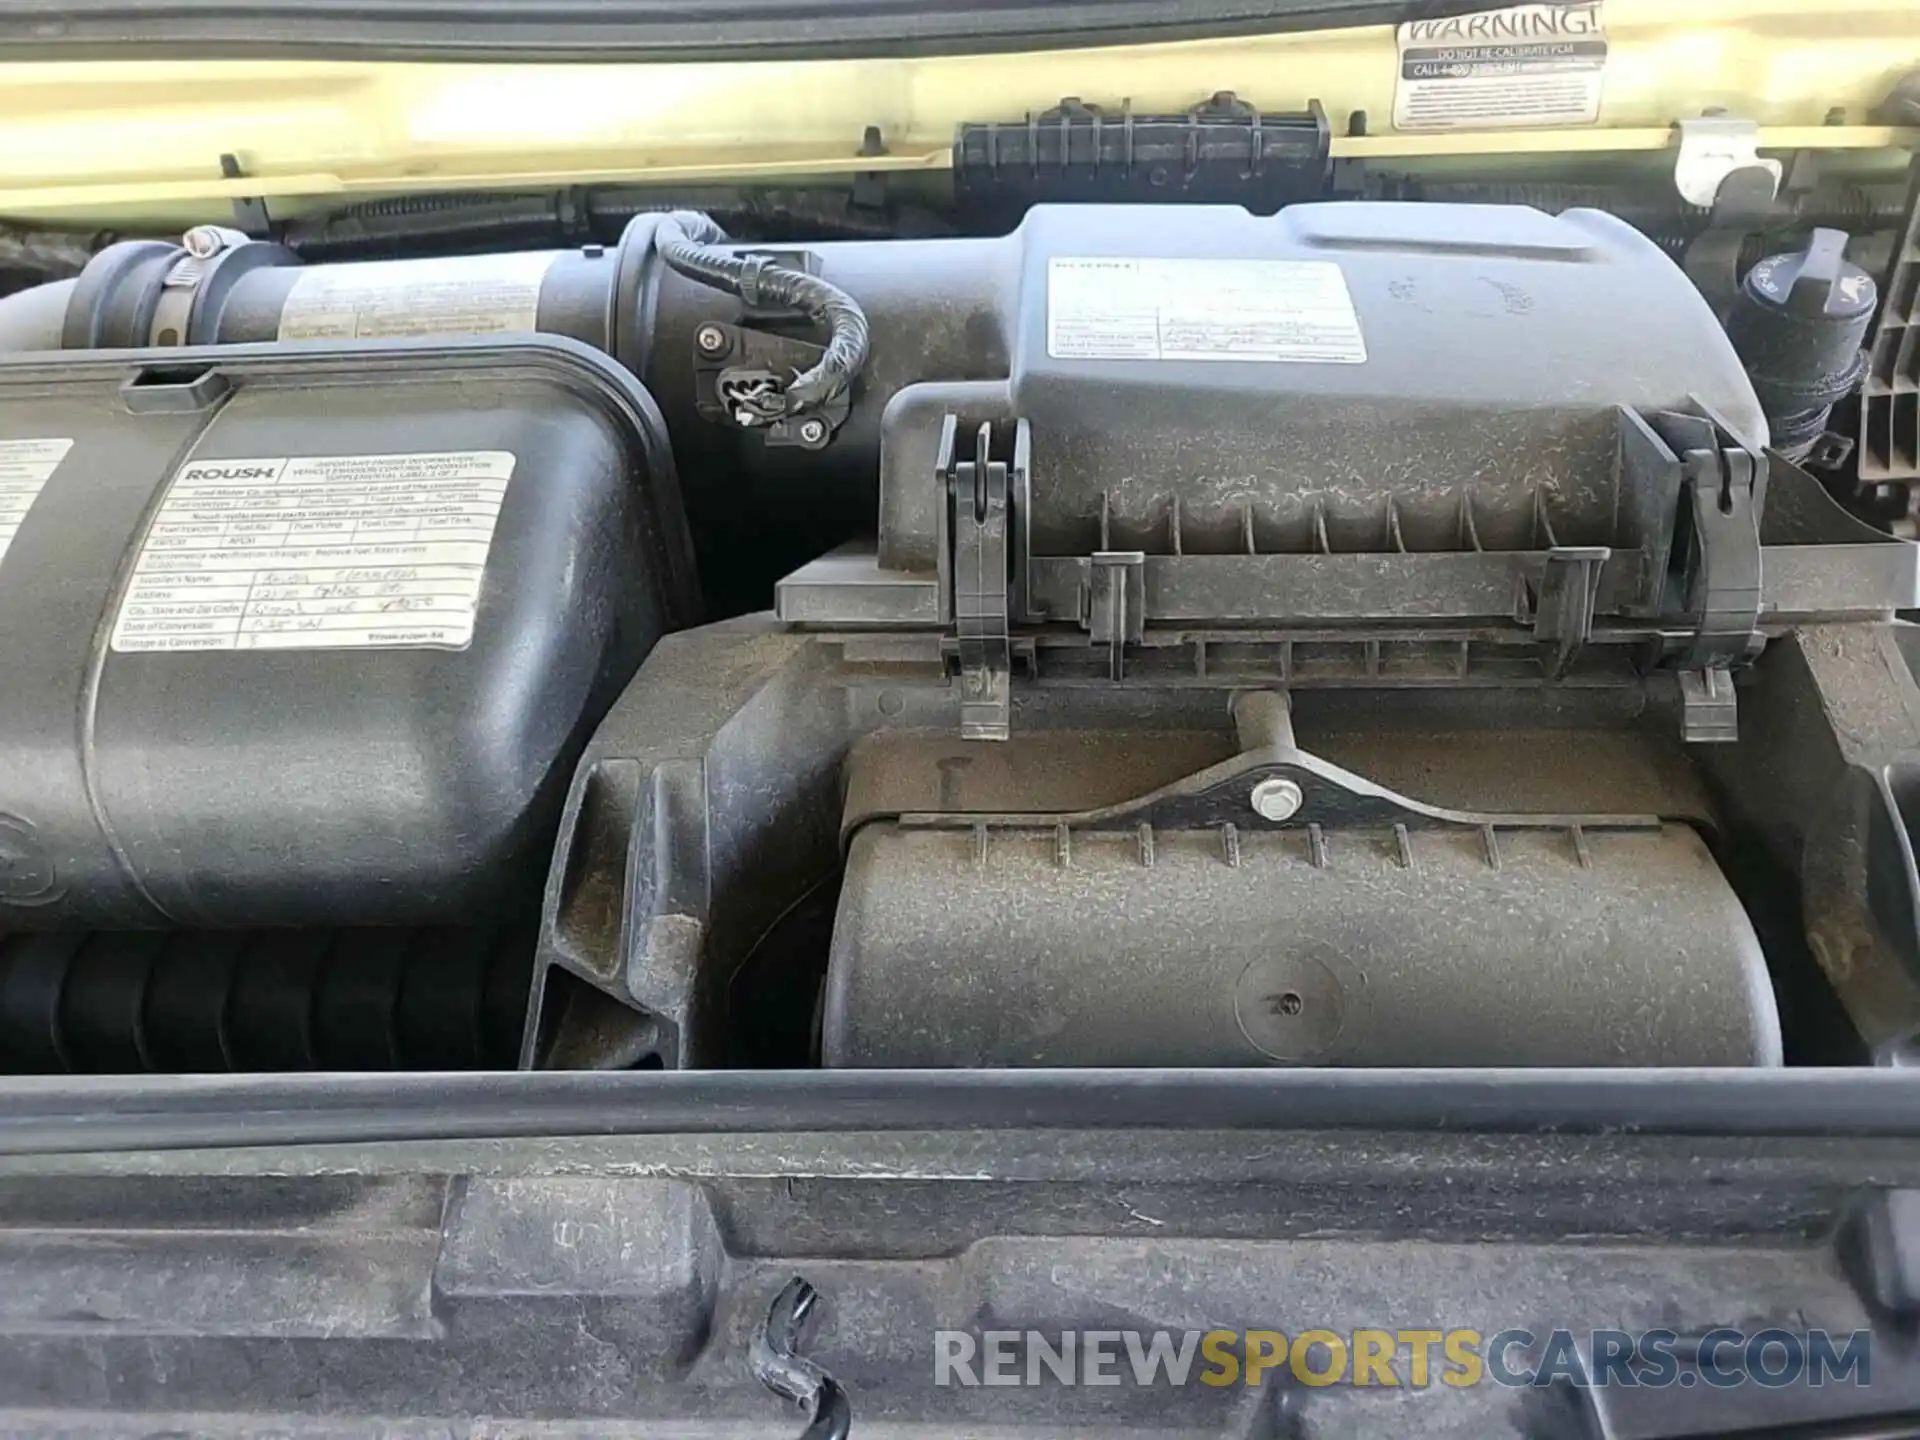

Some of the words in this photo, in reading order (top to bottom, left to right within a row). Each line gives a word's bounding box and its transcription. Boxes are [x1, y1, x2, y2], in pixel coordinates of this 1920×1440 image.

[1409, 9, 1600, 41] WARNING!
[1413, 63, 1439, 77] CALL
[184, 467, 276, 481] ROUSH
